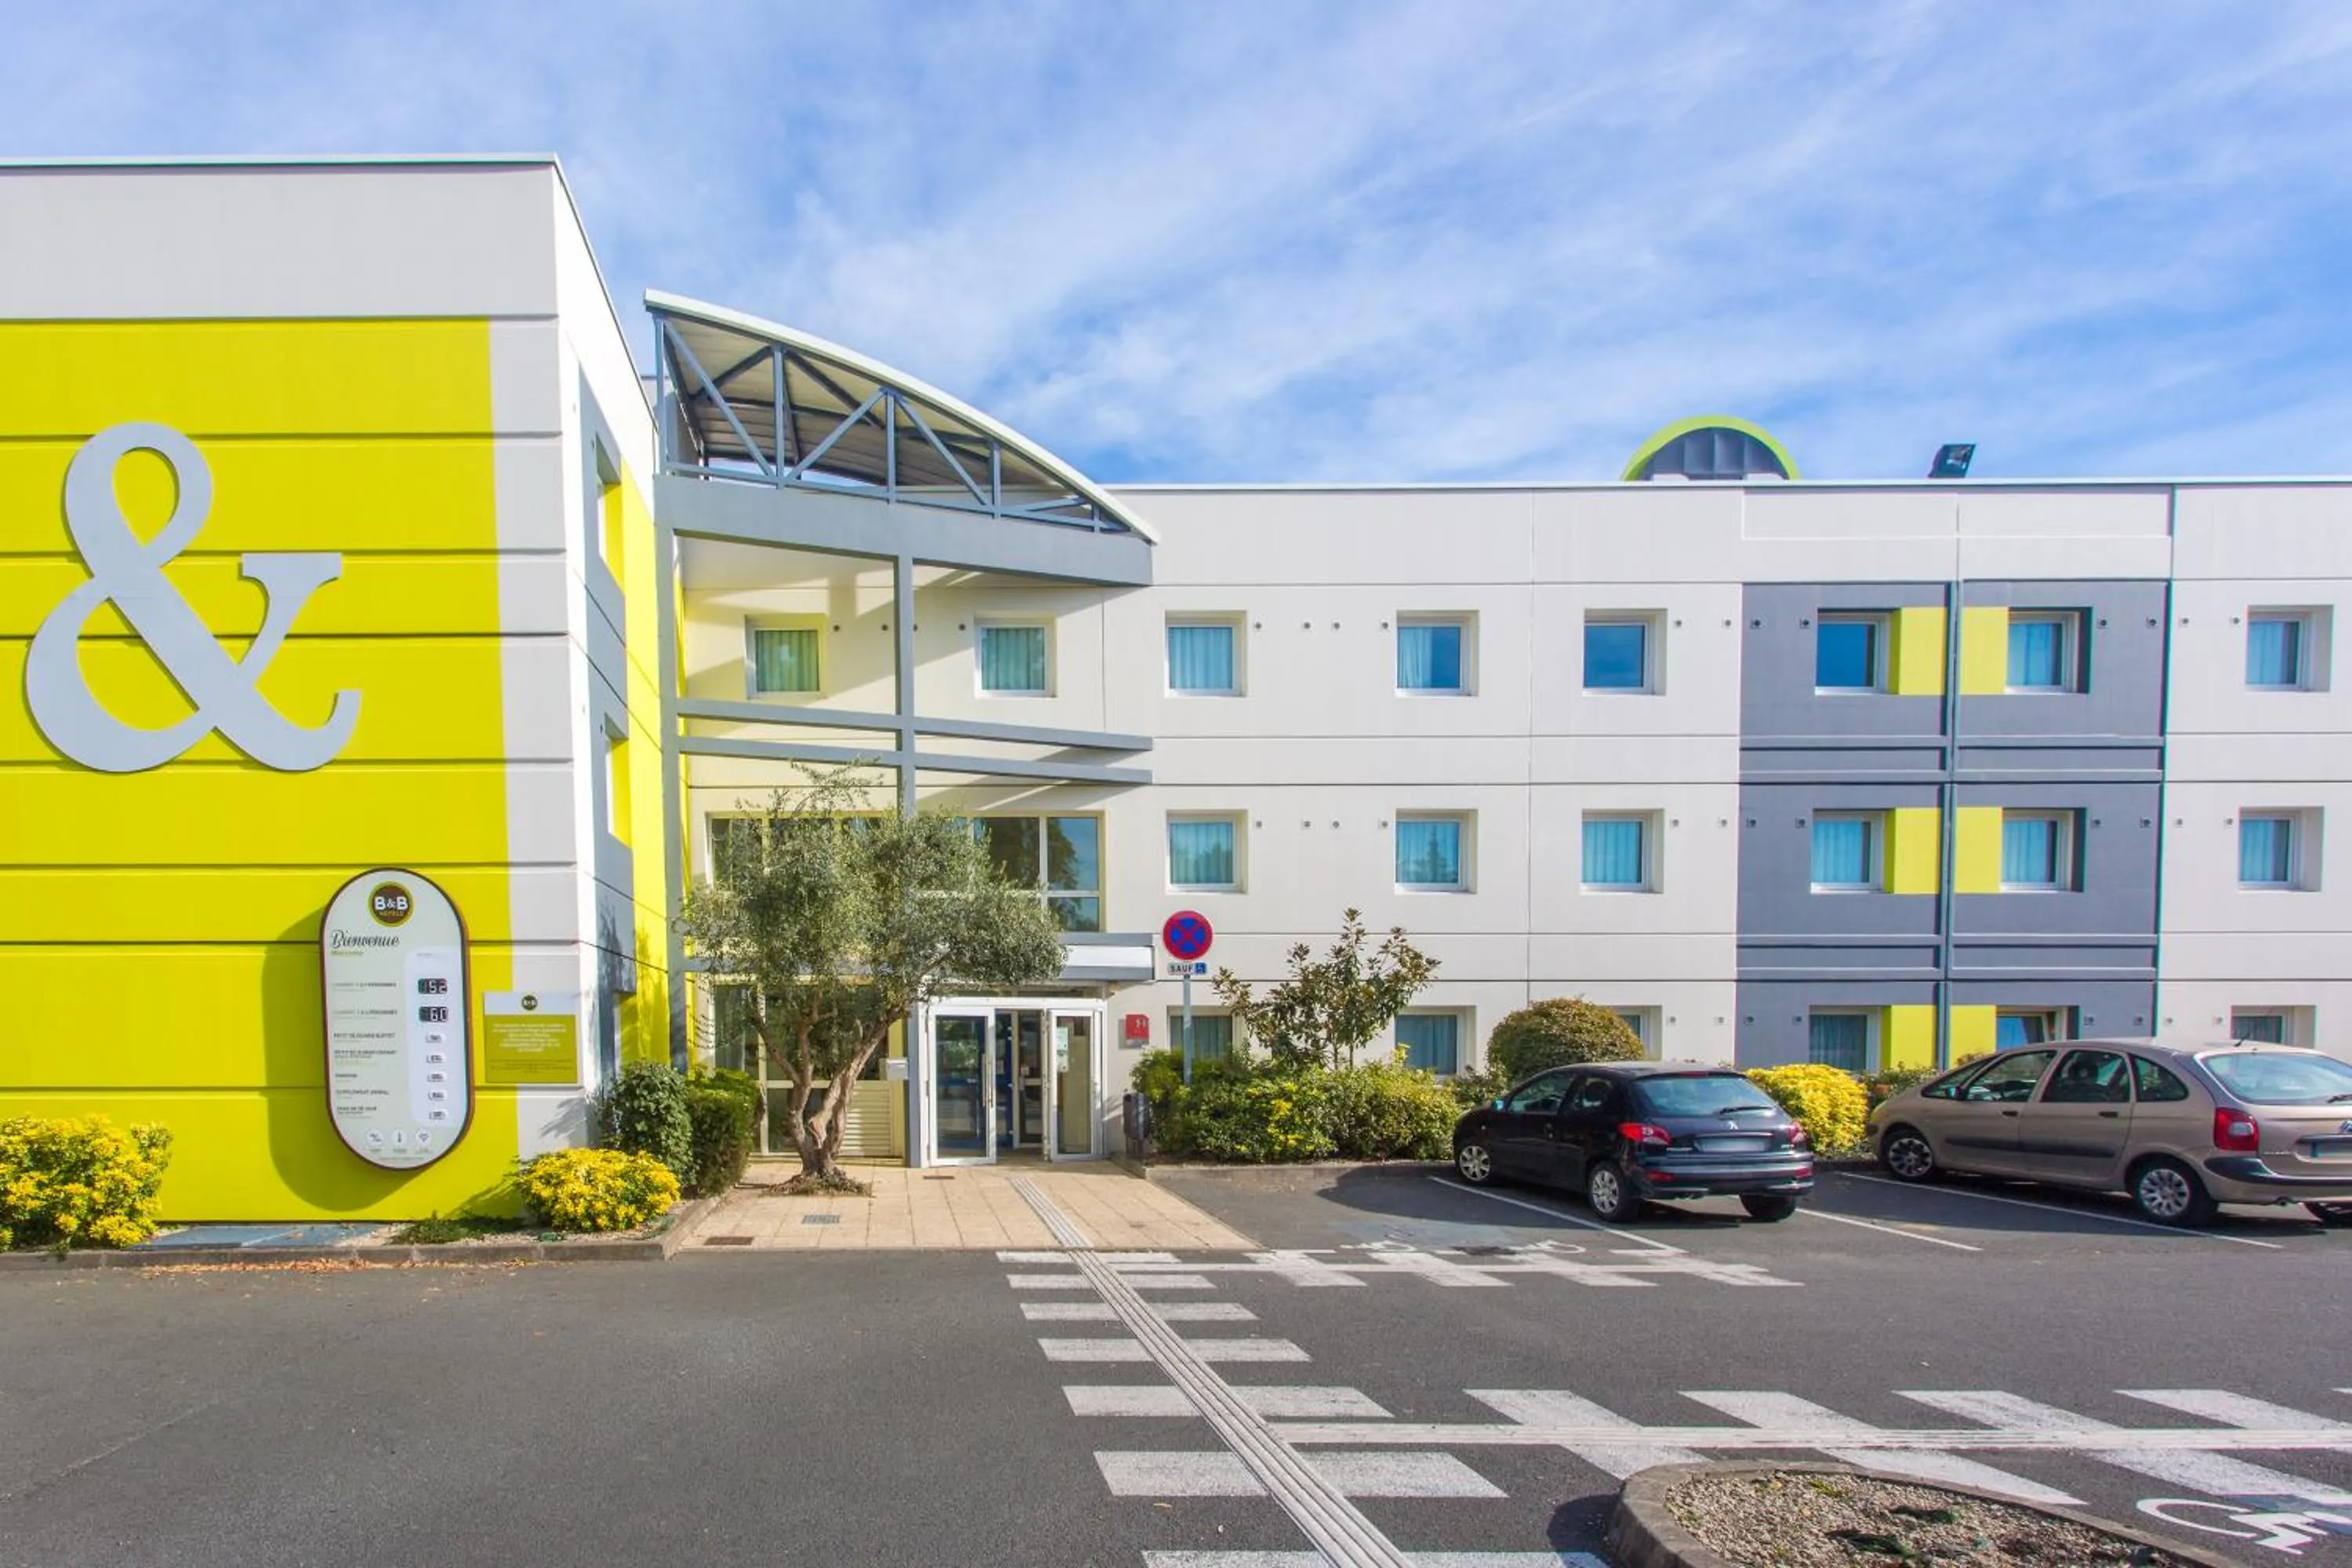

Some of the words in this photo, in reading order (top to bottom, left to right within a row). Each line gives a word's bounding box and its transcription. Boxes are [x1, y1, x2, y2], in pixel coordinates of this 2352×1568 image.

[26, 421, 362, 772] &
[374, 896, 408, 911] B&B
[330, 929, 400, 949] Bienvenue
